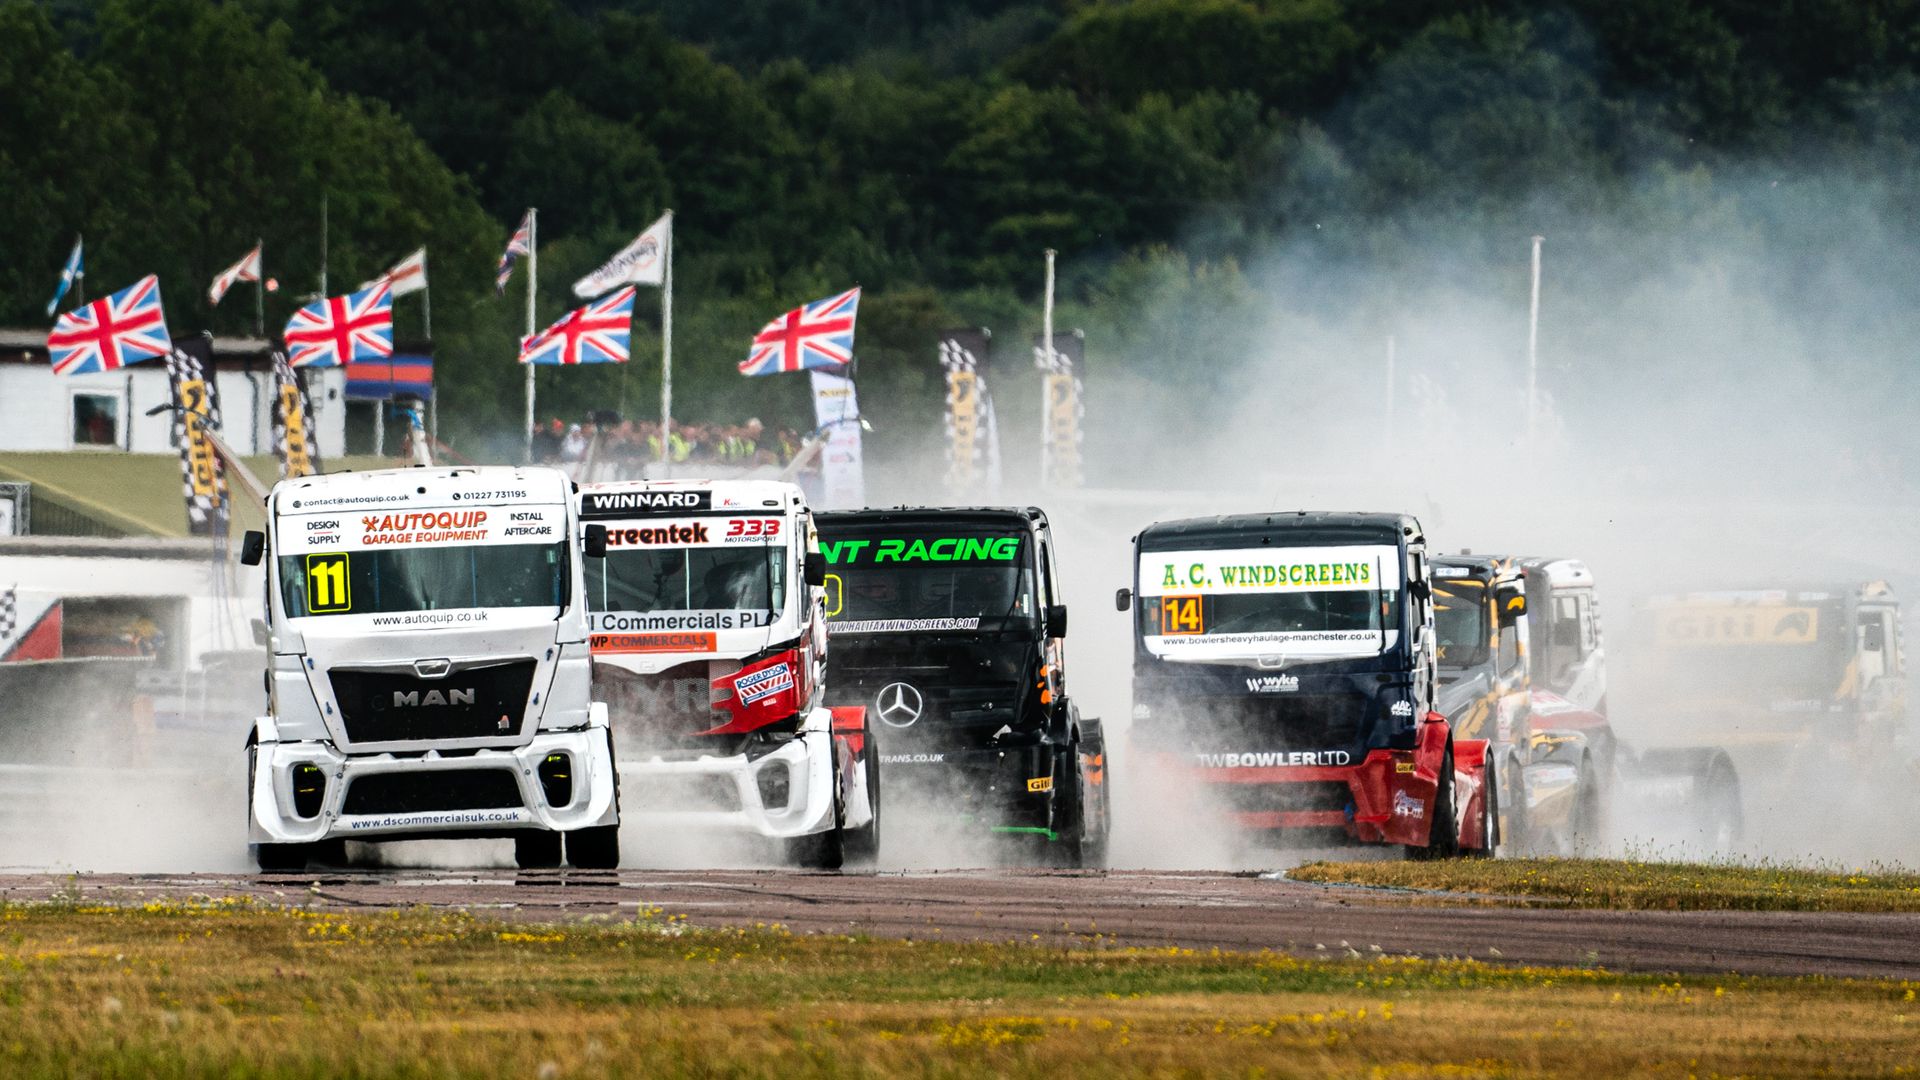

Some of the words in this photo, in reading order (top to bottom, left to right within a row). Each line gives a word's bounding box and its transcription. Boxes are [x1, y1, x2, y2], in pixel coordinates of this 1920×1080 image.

[304, 494, 410, 506] contact@autoquip.co.uk
[463, 491, 492, 500] 01227
[495, 490, 527, 499] 731195
[593, 493, 700, 509] WINNARD
[379, 511, 488, 532] AUTOQUIP
[510, 512, 544, 521] INSTALL
[307, 520, 340, 531] DESIGN
[504, 526, 552, 536] AFTERCARE
[605, 522, 709, 545] creentek
[726, 519, 781, 536] 333
[308, 535, 341, 545] SUPPLY
[362, 533, 412, 545] GARAGE
[416, 529, 488, 543] EQUIPMENT
[724, 535, 777, 543] MOTORSPORT
[875, 537, 1020, 562] RACING
[311, 560, 346, 606] 11
[1162, 563, 1213, 588] A.C.
[1219, 562, 1371, 587] WINDSCREENS
[373, 611, 488, 626] www.autoquip.co.uk
[602, 612, 732, 630] Commercials
[1165, 598, 1199, 631] 14
[611, 635, 707, 648] COMMERCIALS
[1163, 633, 1377, 645] www.bowlersheavyhaulage-manchester.co.uk
[736, 674, 762, 689] ROGER
[762, 663, 788, 678] DYSON
[1263, 673, 1299, 688] wyke
[393, 688, 475, 708] MAN
[352, 811, 519, 829] www.dscommercialsuk.co.uk
